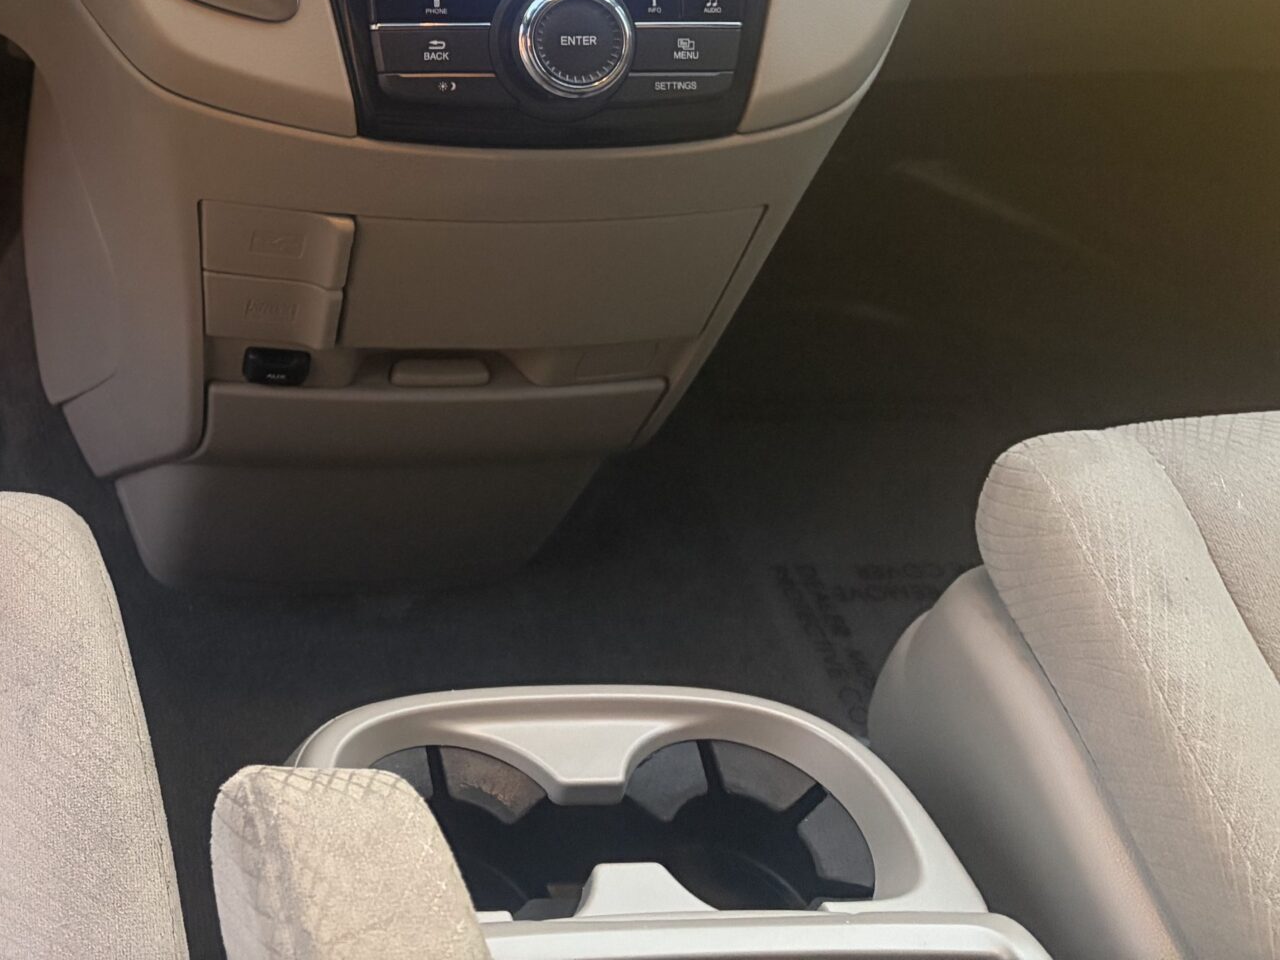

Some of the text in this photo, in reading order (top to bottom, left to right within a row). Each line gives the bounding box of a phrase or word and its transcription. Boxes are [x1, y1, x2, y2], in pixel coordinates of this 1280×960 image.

[560, 35, 597, 46] ENTER
[423, 52, 449, 61] BACK
[673, 50, 699, 60] MENU
[654, 81, 697, 91] SETTINGS
